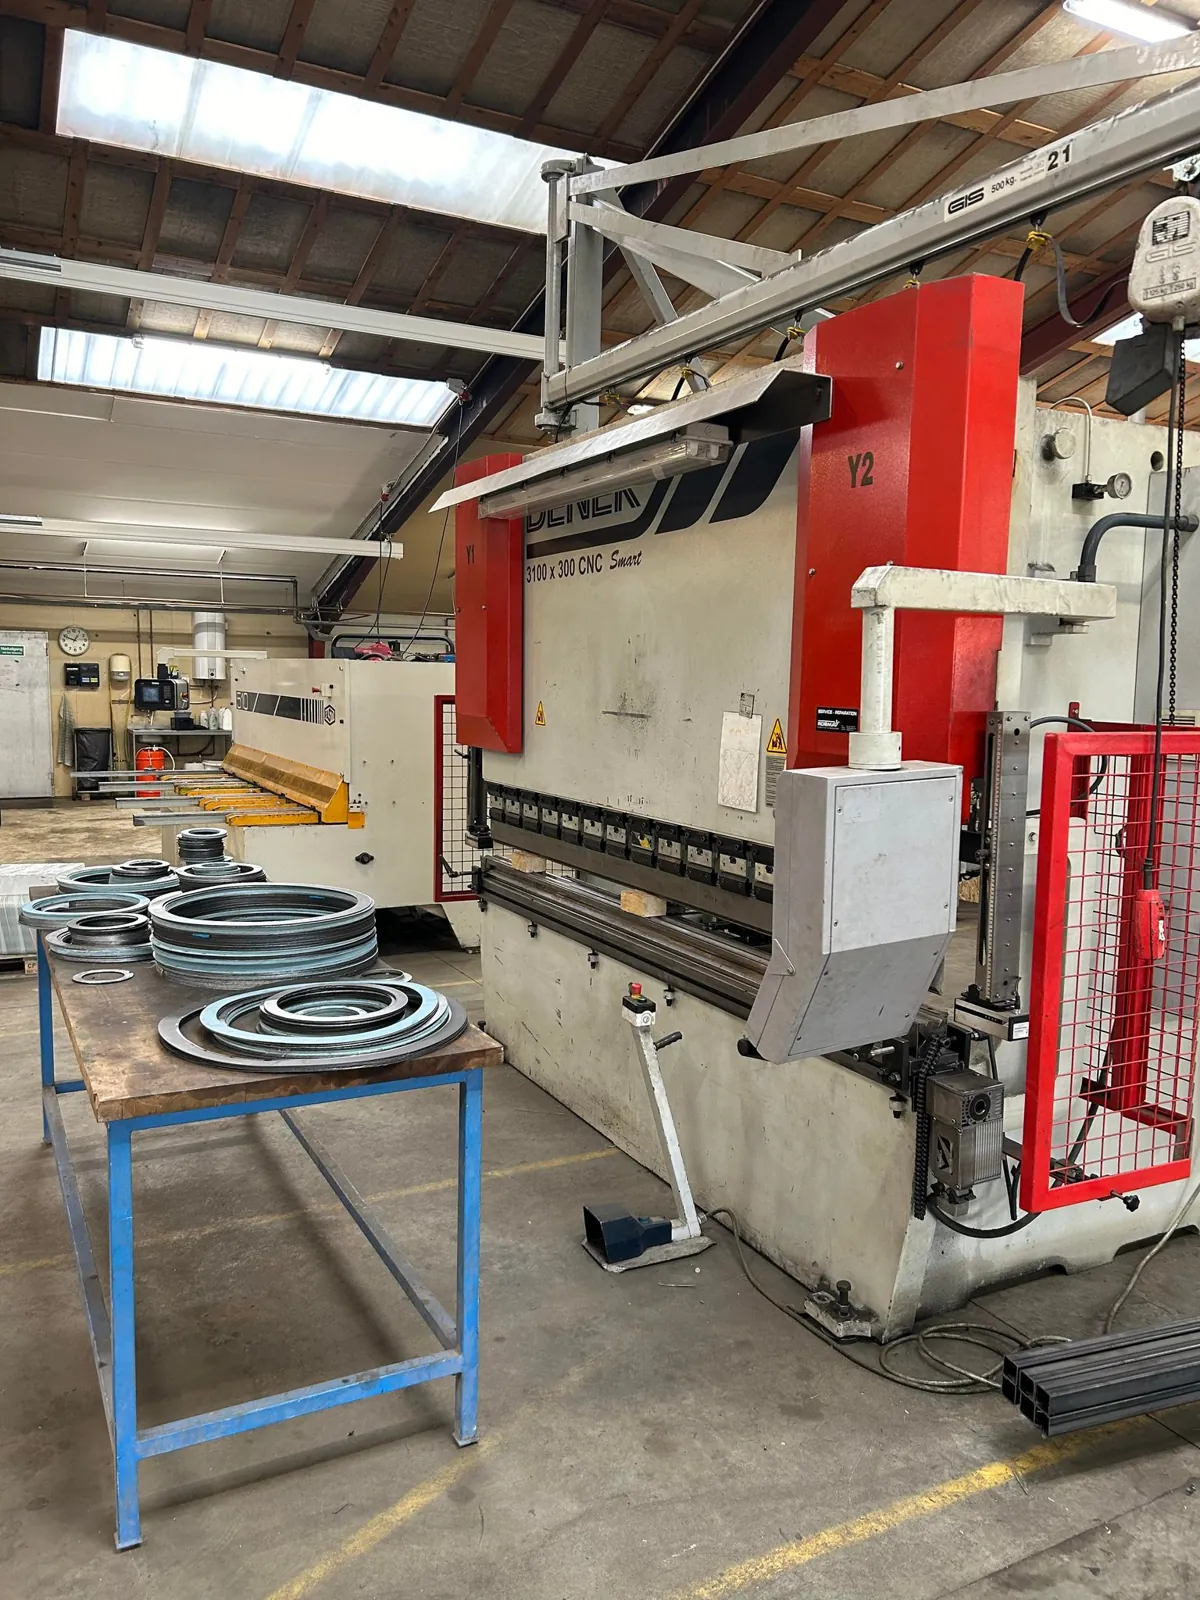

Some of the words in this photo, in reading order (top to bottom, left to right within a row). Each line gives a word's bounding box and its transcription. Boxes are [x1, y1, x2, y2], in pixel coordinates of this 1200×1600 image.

[1047, 144, 1070, 171] 21
[948, 187, 984, 214] GIS
[991, 181, 1005, 193] 500
[1145, 241, 1196, 263] GIS
[848, 451, 874, 488] Y2
[466, 545, 475, 564] Y1
[526, 563, 547, 583] 3100
[549, 565, 555, 579] x
[558, 558, 575, 578] 300
[578, 553, 603, 575] CNC
[609, 549, 642, 570] Smart
